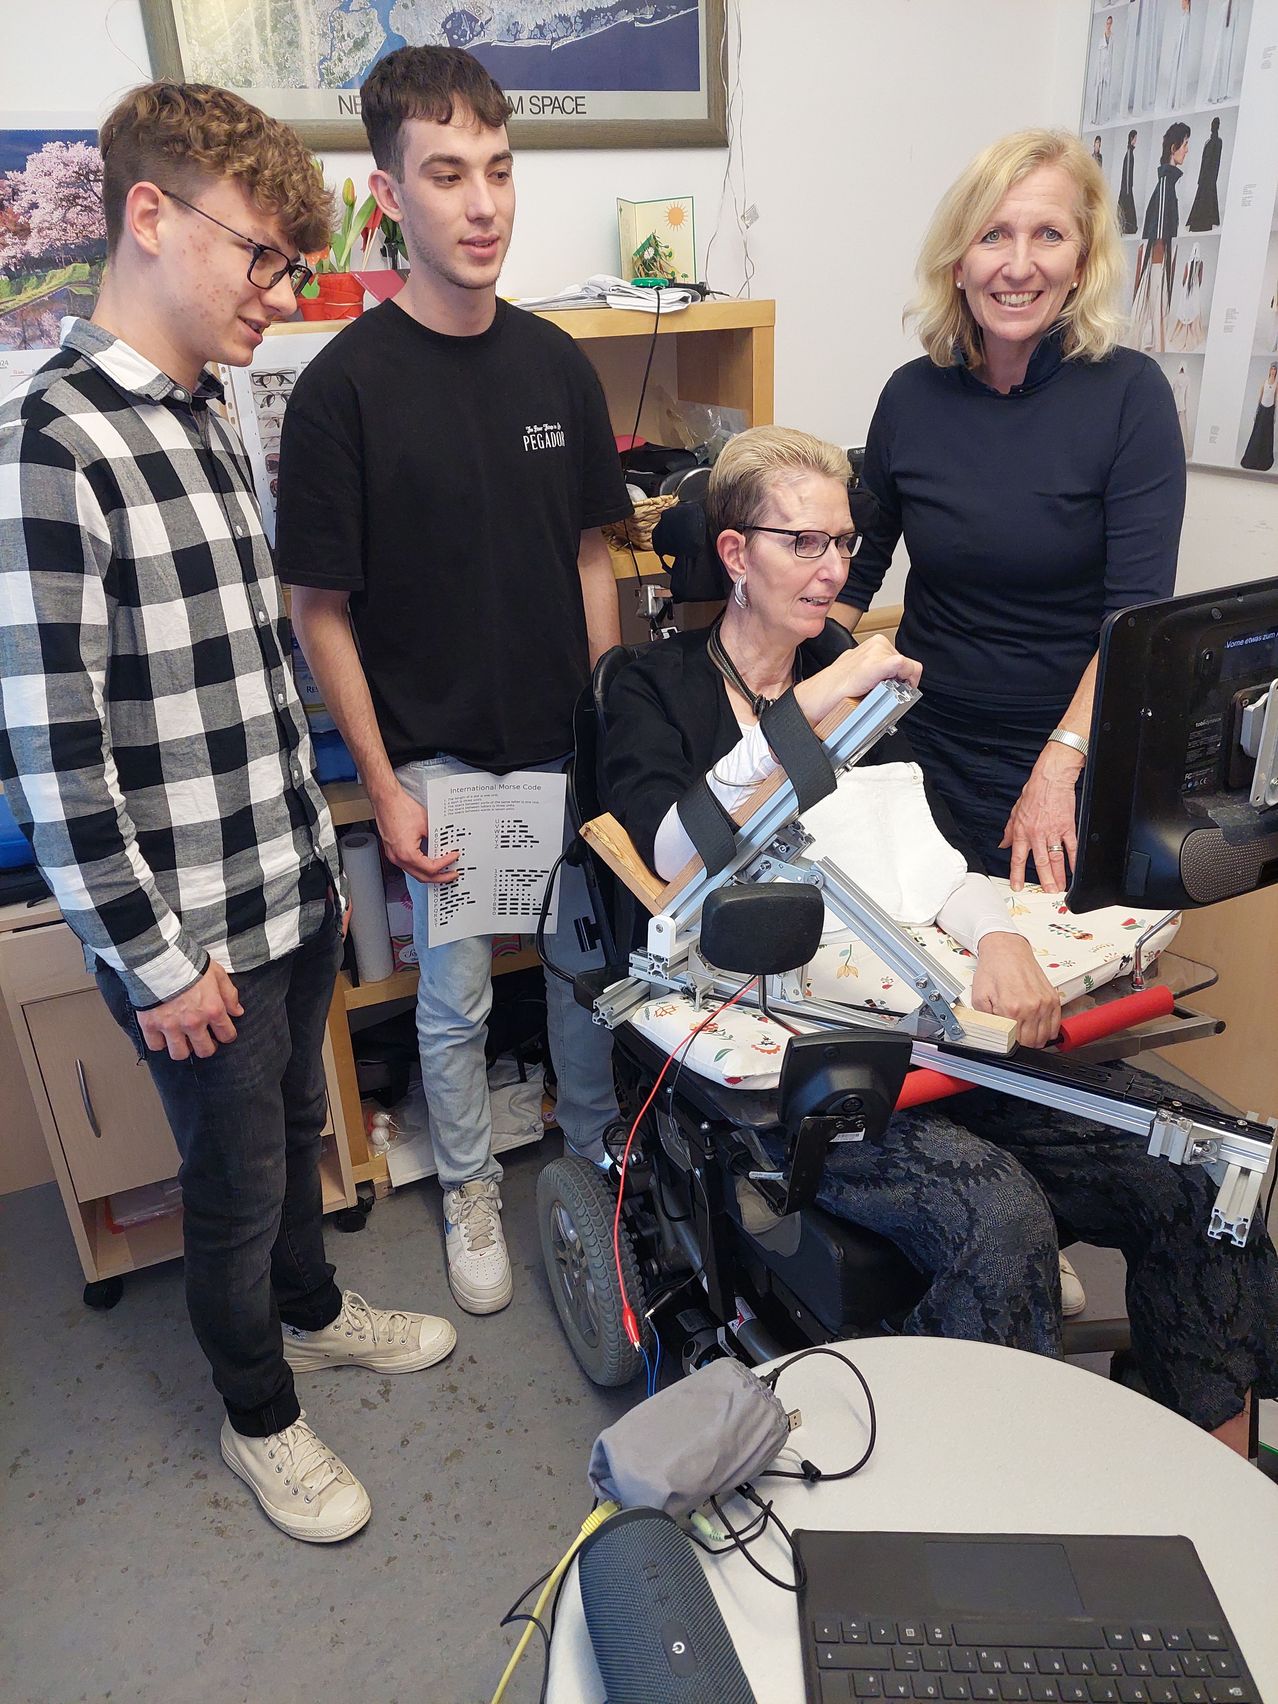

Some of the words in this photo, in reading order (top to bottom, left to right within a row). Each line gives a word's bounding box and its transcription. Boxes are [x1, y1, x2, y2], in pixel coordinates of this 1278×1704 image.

[338, 96, 362, 115] NE
[529, 95, 586, 115] SPACE
[450, 784, 496, 794] International
